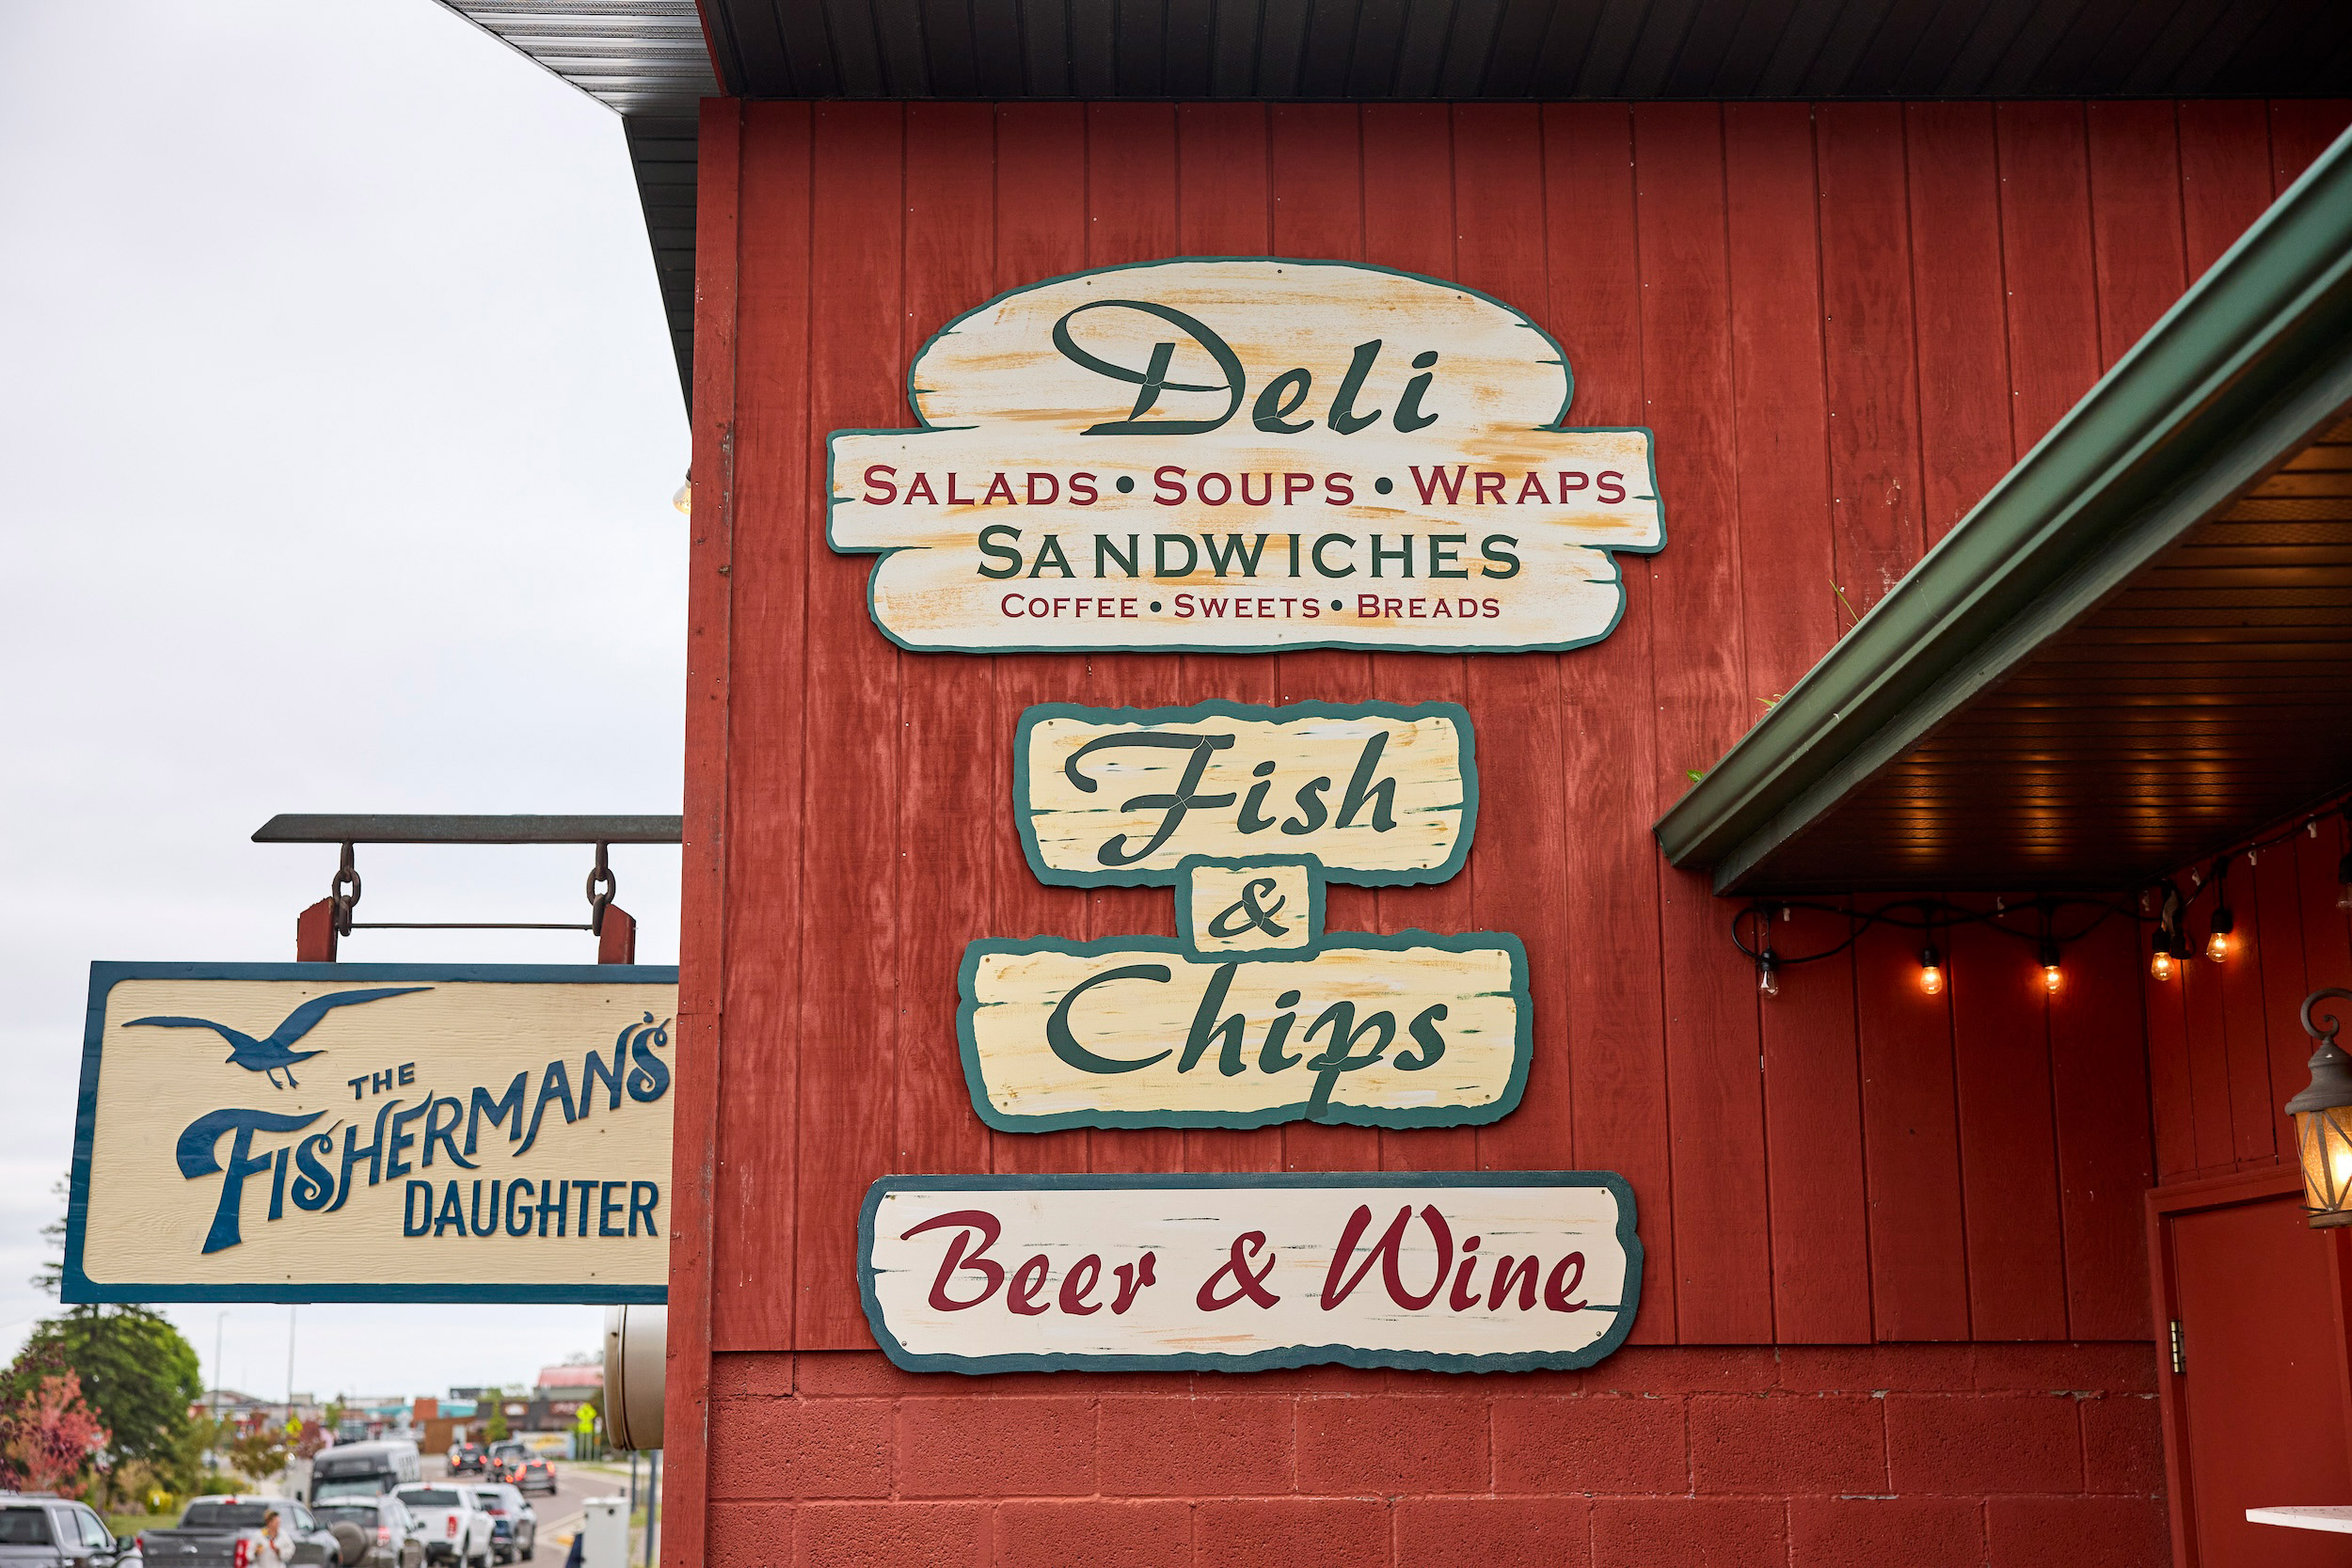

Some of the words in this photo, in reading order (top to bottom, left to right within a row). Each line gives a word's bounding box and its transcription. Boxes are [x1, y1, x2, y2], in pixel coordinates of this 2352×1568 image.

[1053, 300, 1439, 436] Deli
[862, 465, 1099, 506] SALADS
[1152, 465, 1355, 506] SOUPS
[1408, 465, 1626, 506] WRAPS
[977, 524, 1520, 580] SANDWICHES
[1001, 594, 1138, 619] COFFEE
[1173, 594, 1321, 619] SWEETS
[1357, 594, 1501, 619] BREADS
[1064, 731, 1397, 866] Fish
[1208, 878, 1290, 938] &
[1046, 960, 1449, 1121] Chips
[347, 1062, 416, 1101] THE
[176, 1010, 672, 1256] FISHERMAN'S
[403, 1178, 660, 1238] DAUGHTER
[899, 1210, 1156, 1316] Beer
[1196, 1230, 1281, 1312] &
[1320, 1203, 1588, 1313] Wine
